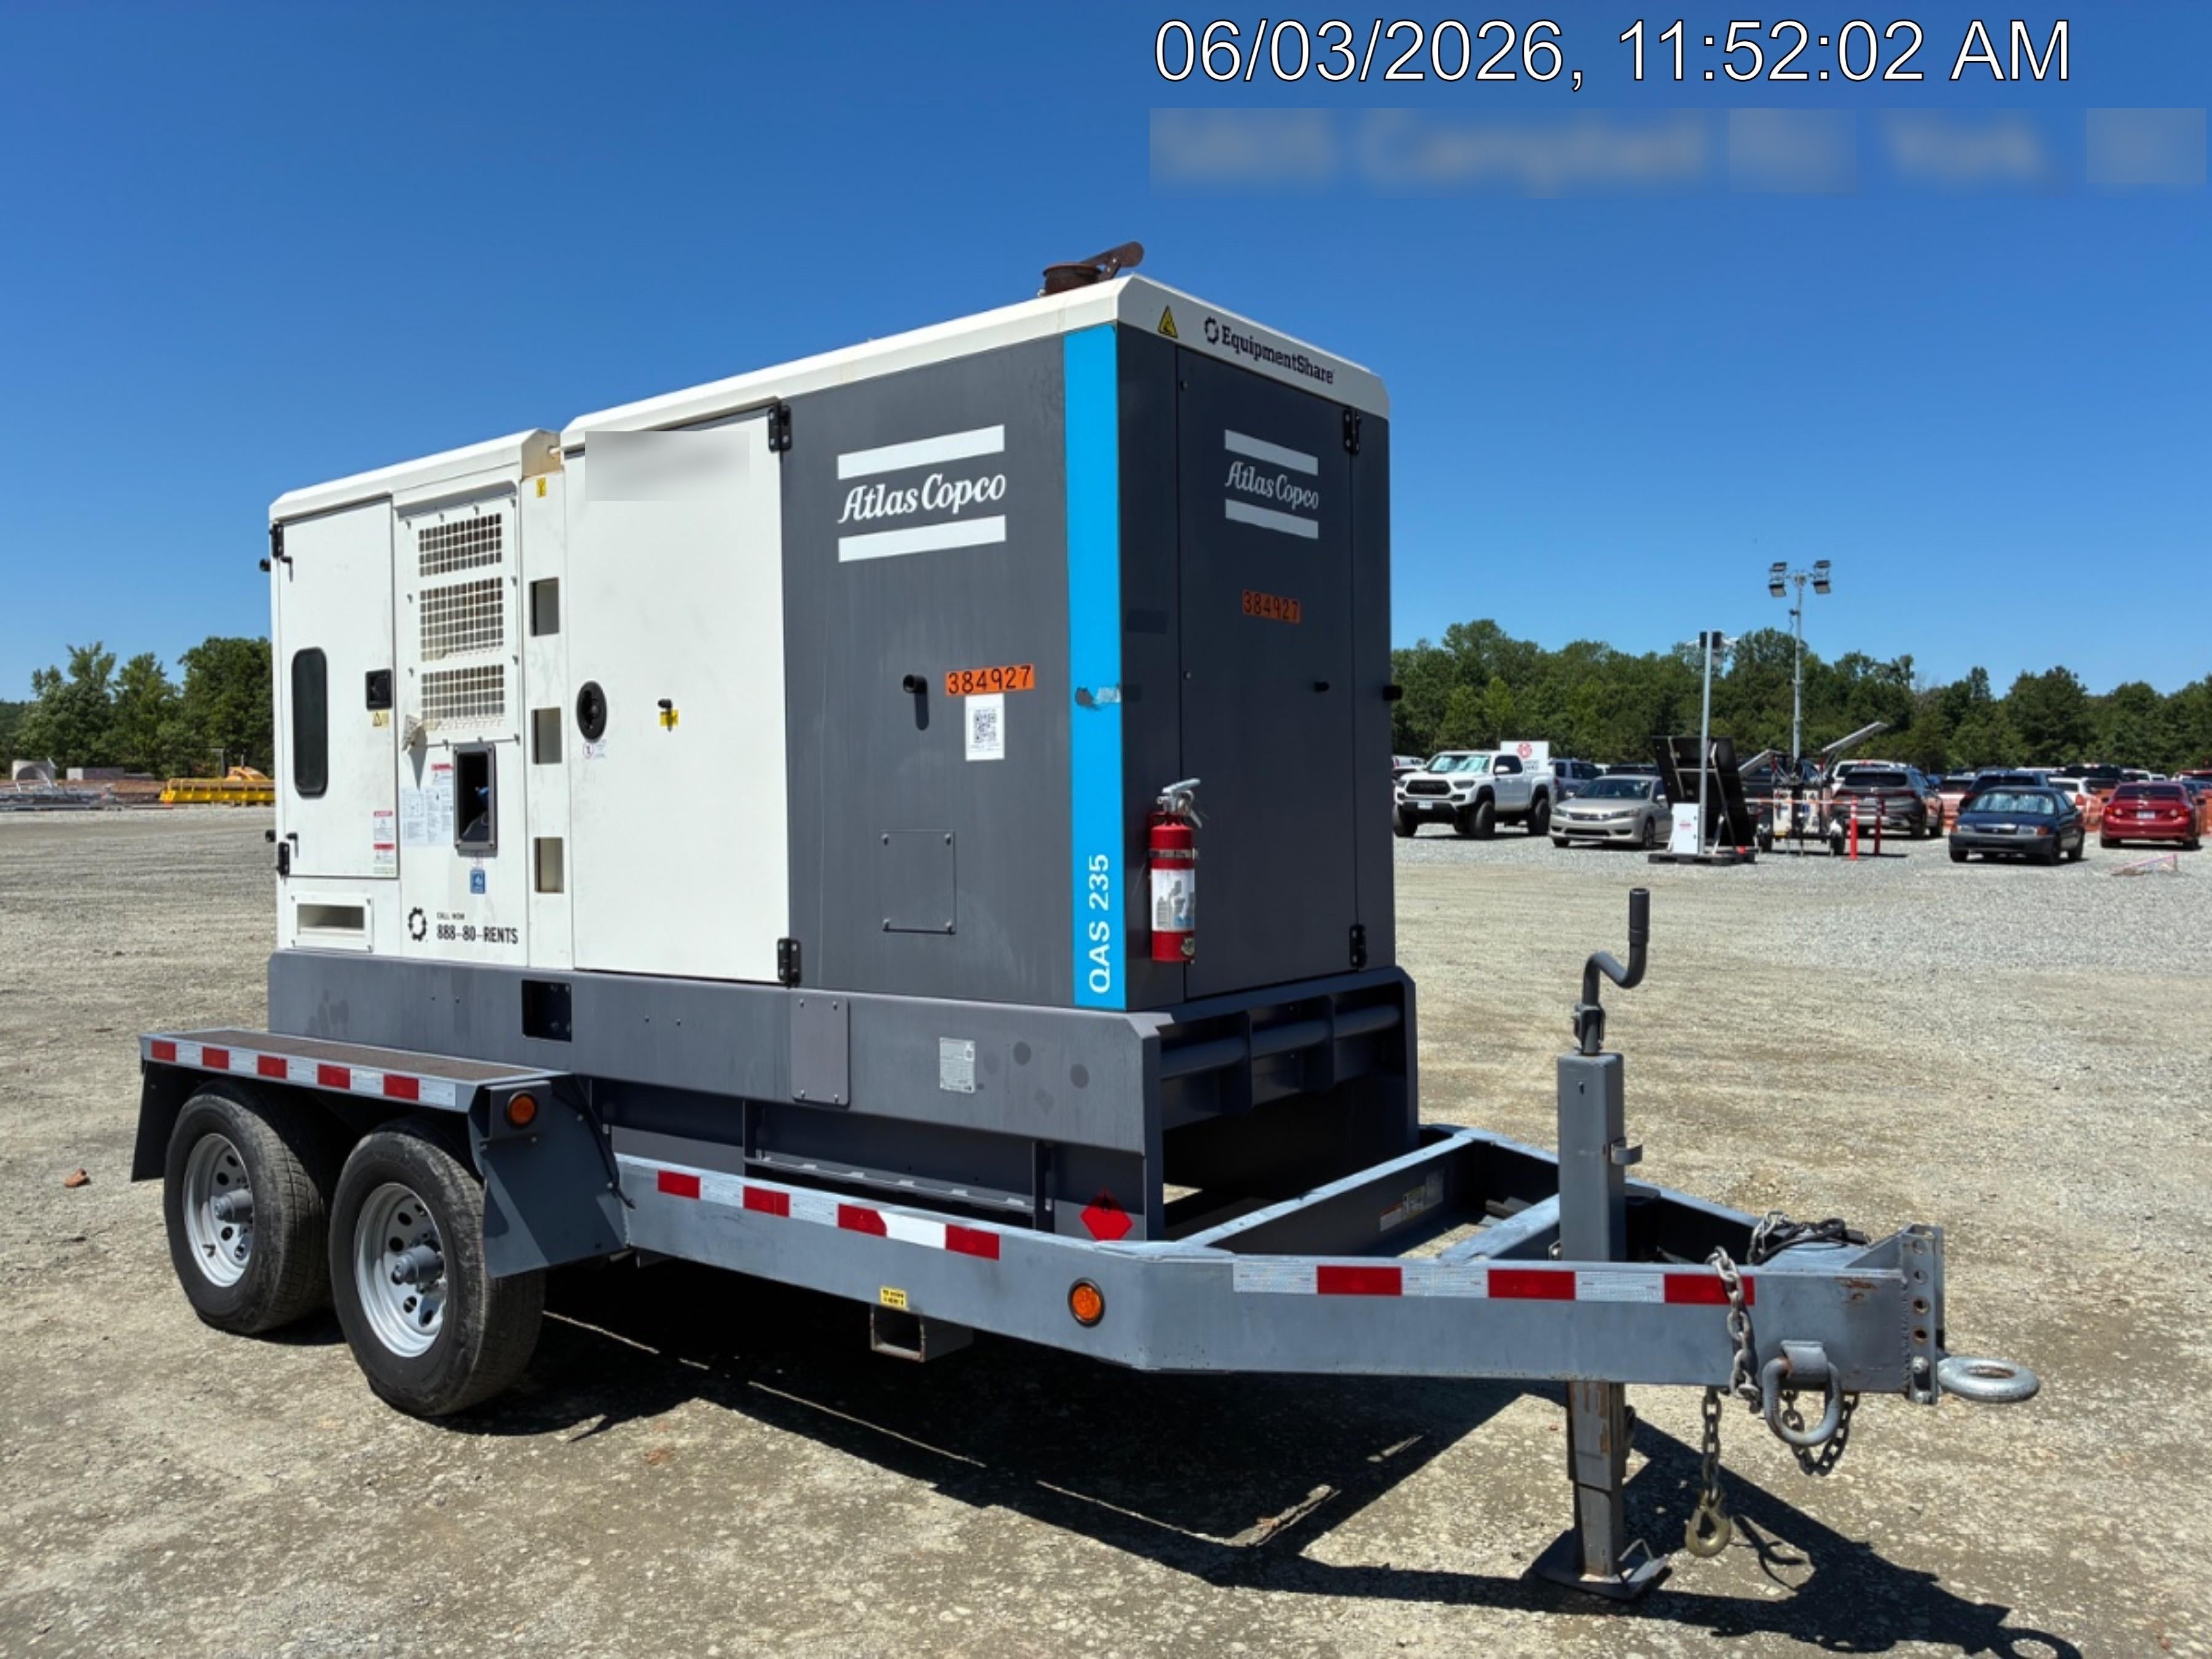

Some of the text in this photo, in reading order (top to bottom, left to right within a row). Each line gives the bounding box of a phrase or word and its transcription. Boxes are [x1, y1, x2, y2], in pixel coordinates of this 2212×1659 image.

[1222, 324, 1334, 384] EquipmentShare
[837, 473, 1006, 524] Atlas Copco
[1225, 461, 1319, 510] Atlas Copco
[1243, 590, 1298, 620] 384927
[948, 665, 1031, 694] 384927
[437, 924, 519, 944] 888-80-RENTS
[1088, 854, 1111, 994] QAS 235
